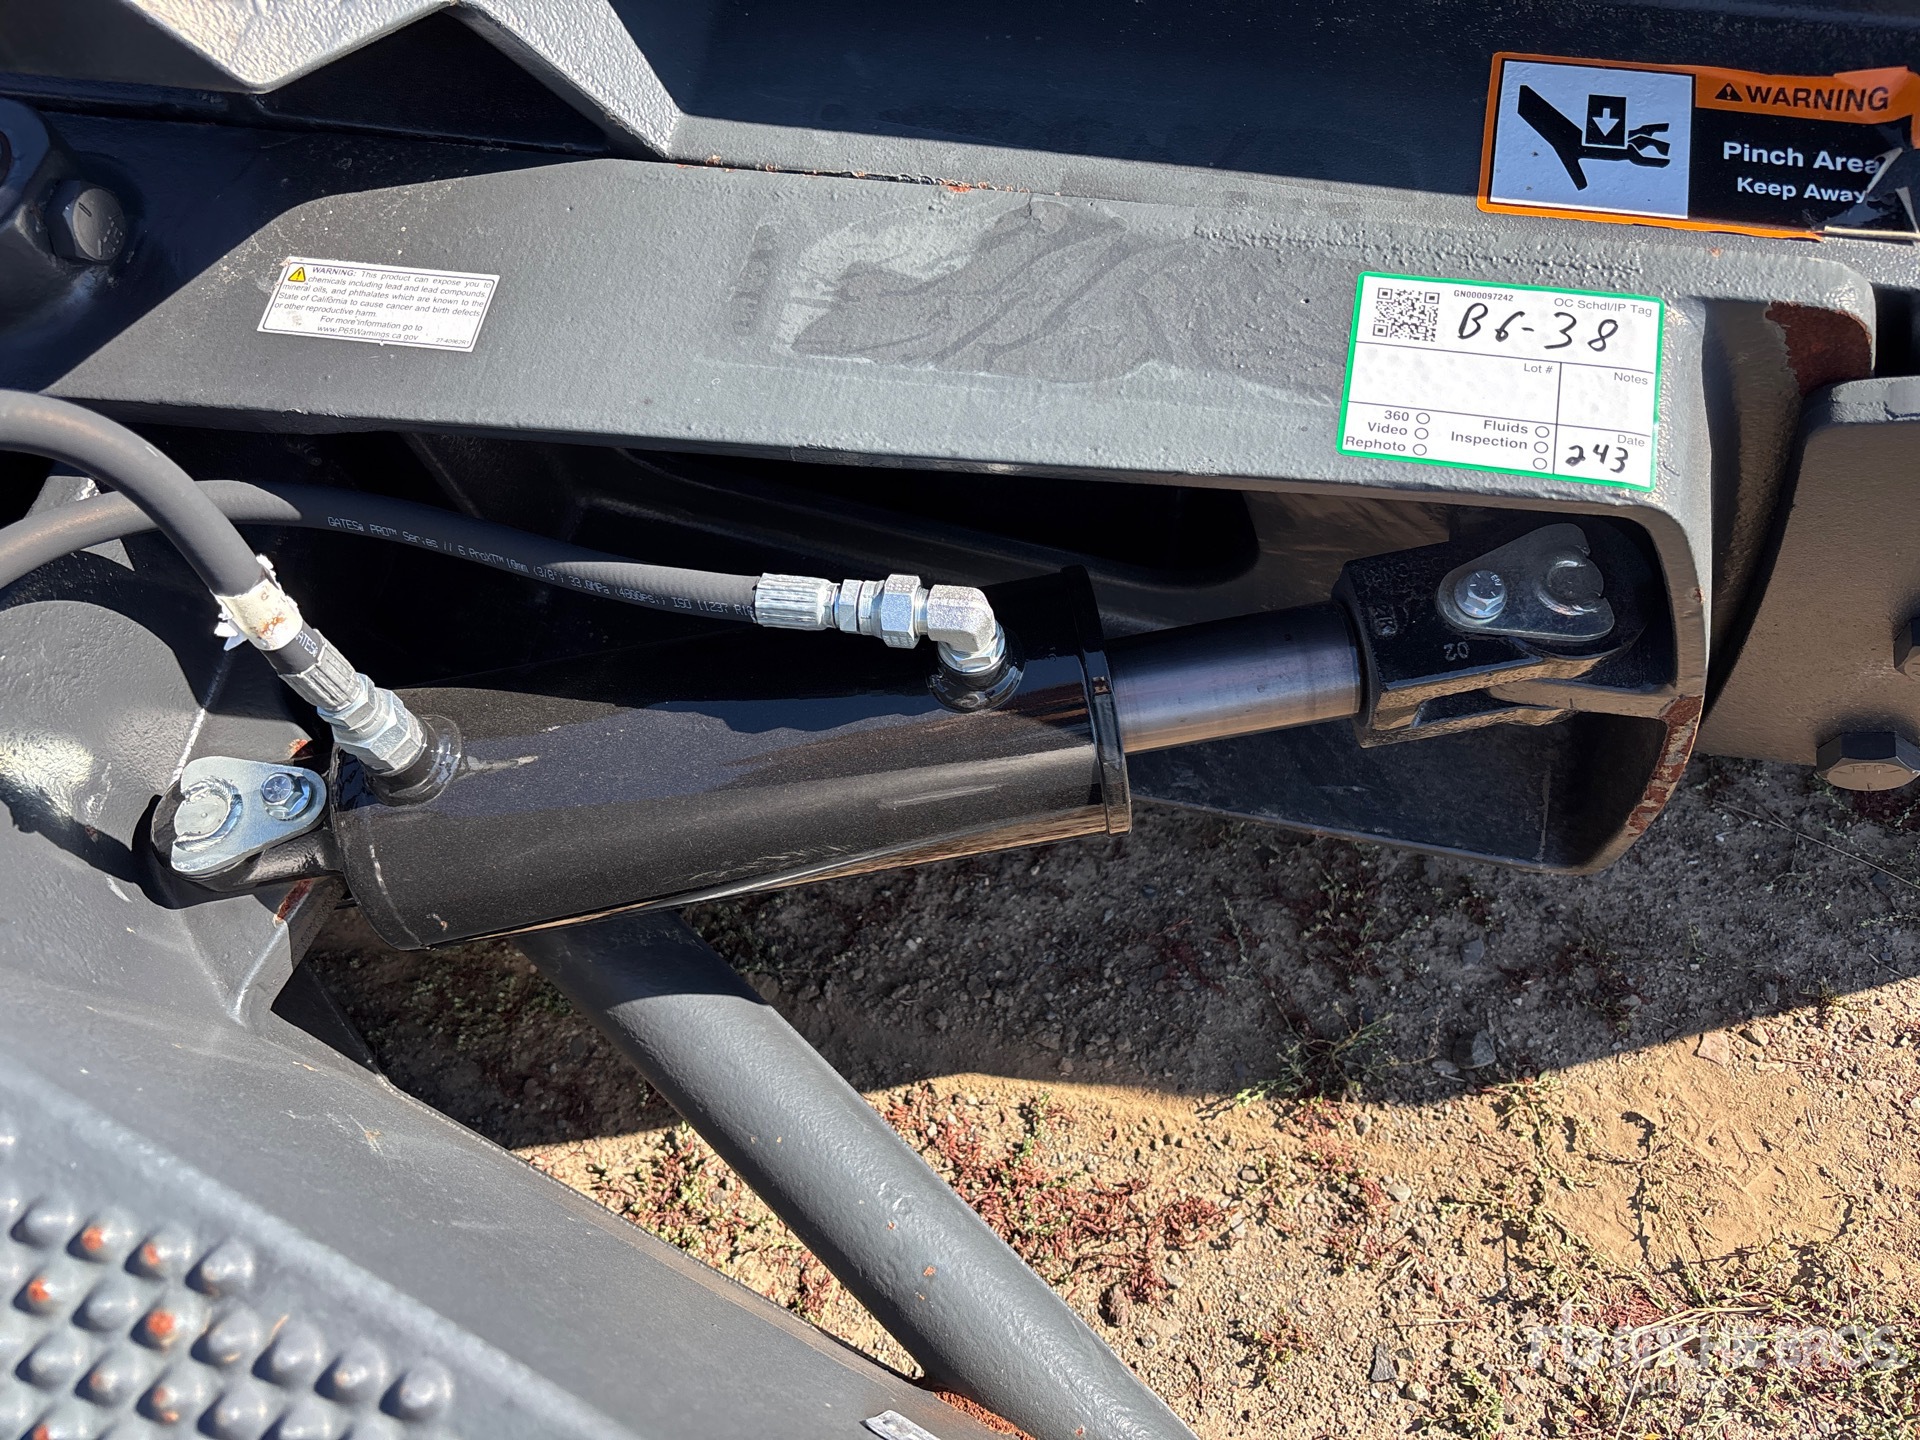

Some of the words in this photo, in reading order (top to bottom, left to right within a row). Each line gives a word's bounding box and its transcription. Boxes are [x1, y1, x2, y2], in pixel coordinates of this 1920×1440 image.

[1745, 85, 1890, 112] WARNING
[1723, 141, 1804, 168] Pinch
[1812, 150, 1881, 175] Area
[1737, 177, 1797, 200] Keep
[1803, 184, 1868, 204] Away
[308, 276, 346, 286] chemicals
[348, 279, 383, 290] including
[384, 282, 402, 290] lead
[403, 284, 419, 292] and
[420, 285, 438, 294] lead
[312, 266, 357, 276] WARNING:
[361, 270, 377, 278] This
[380, 273, 411, 282] product
[432, 278, 461, 287] expose
[278, 291, 299, 301] State
[311, 295, 348, 305] California
[349, 298, 358, 306] to
[385, 303, 413, 311] cancer
[414, 304, 431, 313] and
[432, 305, 450, 314] birth
[452, 308, 481, 317] defects
[282, 283, 311, 292] mineral
[312, 286, 328, 294] oils,
[330, 287, 346, 295] and
[348, 289, 389, 299] phthalates
[391, 293, 414, 301] which
[432, 297, 459, 305] known
[471, 300, 484, 308] the
[1453, 289, 1514, 302] GN000097242
[1554, 297, 1574, 308] OC
[1630, 304, 1653, 317] Tag
[284, 302, 305, 311] other
[305, 304, 354, 316] reproductive
[320, 315, 335, 323] For
[335, 318, 356, 326] more
[356, 319, 401, 329] information
[402, 324, 413, 332] go
[414, 324, 423, 332] to
[1457, 302, 1619, 352] B6-38
[1523, 363, 1542, 374] Lot
[1545, 365, 1553, 374] #
[1613, 372, 1649, 385] Notes
[1384, 409, 1410, 422] 360
[1367, 421, 1408, 436] Video
[1483, 419, 1529, 434] Fluids
[1345, 435, 1406, 452] Rephoto
[1450, 430, 1528, 450] Inspection
[1617, 434, 1645, 447] Date
[1565, 443, 1629, 474] 243
[402, 531, 438, 548] Series
[457, 544, 466, 556] 6
[671, 596, 692, 609] ISO
[698, 600, 729, 614] 11237
